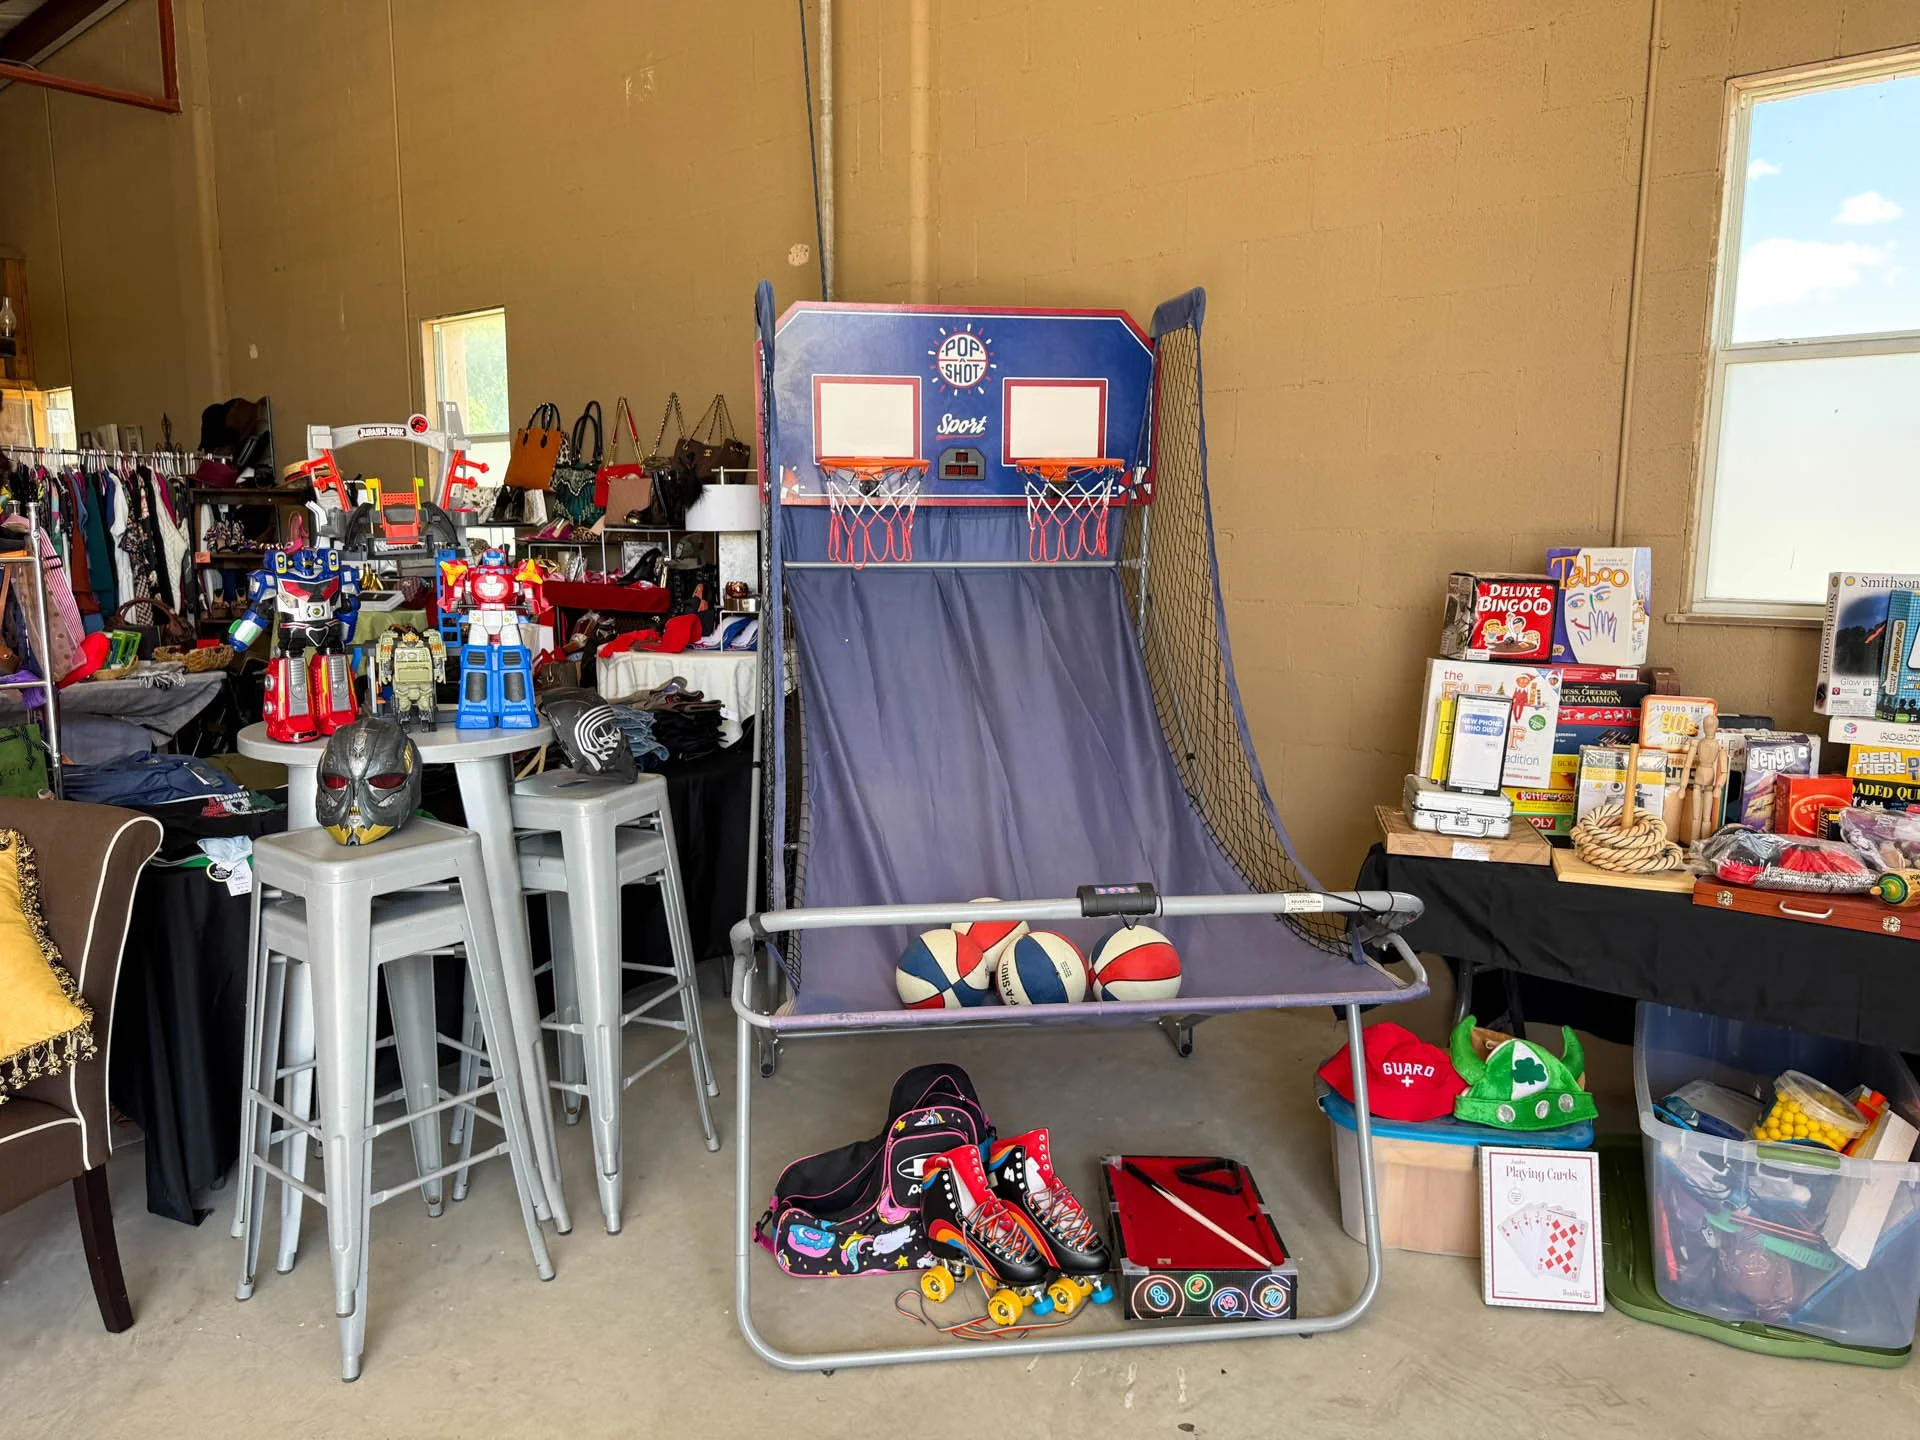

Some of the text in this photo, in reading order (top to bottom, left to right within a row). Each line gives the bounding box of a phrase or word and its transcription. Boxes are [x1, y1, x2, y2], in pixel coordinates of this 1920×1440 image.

[945, 336, 980, 358] POP
[945, 363, 980, 383] SHOT
[936, 413, 987, 434] Sport
[387, 428, 406, 437] PARK
[1551, 554, 1629, 590] Taboo
[1861, 576, 1920, 589] Smithson
[1489, 584, 1541, 597] DELUXE
[1479, 597, 1532, 613] BINGO
[1822, 593, 1838, 674] Smithsonian
[1444, 671, 1464, 681] the
[1840, 678, 1862, 686] Glow
[1581, 686, 1619, 697] CHECKERS,
[1560, 695, 1621, 704] ACKGAMMON
[1661, 711, 1698, 736] 90s
[1880, 732, 1920, 742] ROBOT
[1504, 754, 1540, 767] adition
[1750, 745, 1795, 772] Jenga
[1857, 751, 1902, 763] BEEN
[1852, 762, 1906, 775] THERE
[1852, 783, 1894, 799] ADED
[1505, 1165, 1578, 1182] Playing Cards
[1150, 1284, 1170, 1306] 8
[1191, 1279, 1203, 1292] 2
[1263, 1289, 1284, 1307] 10
